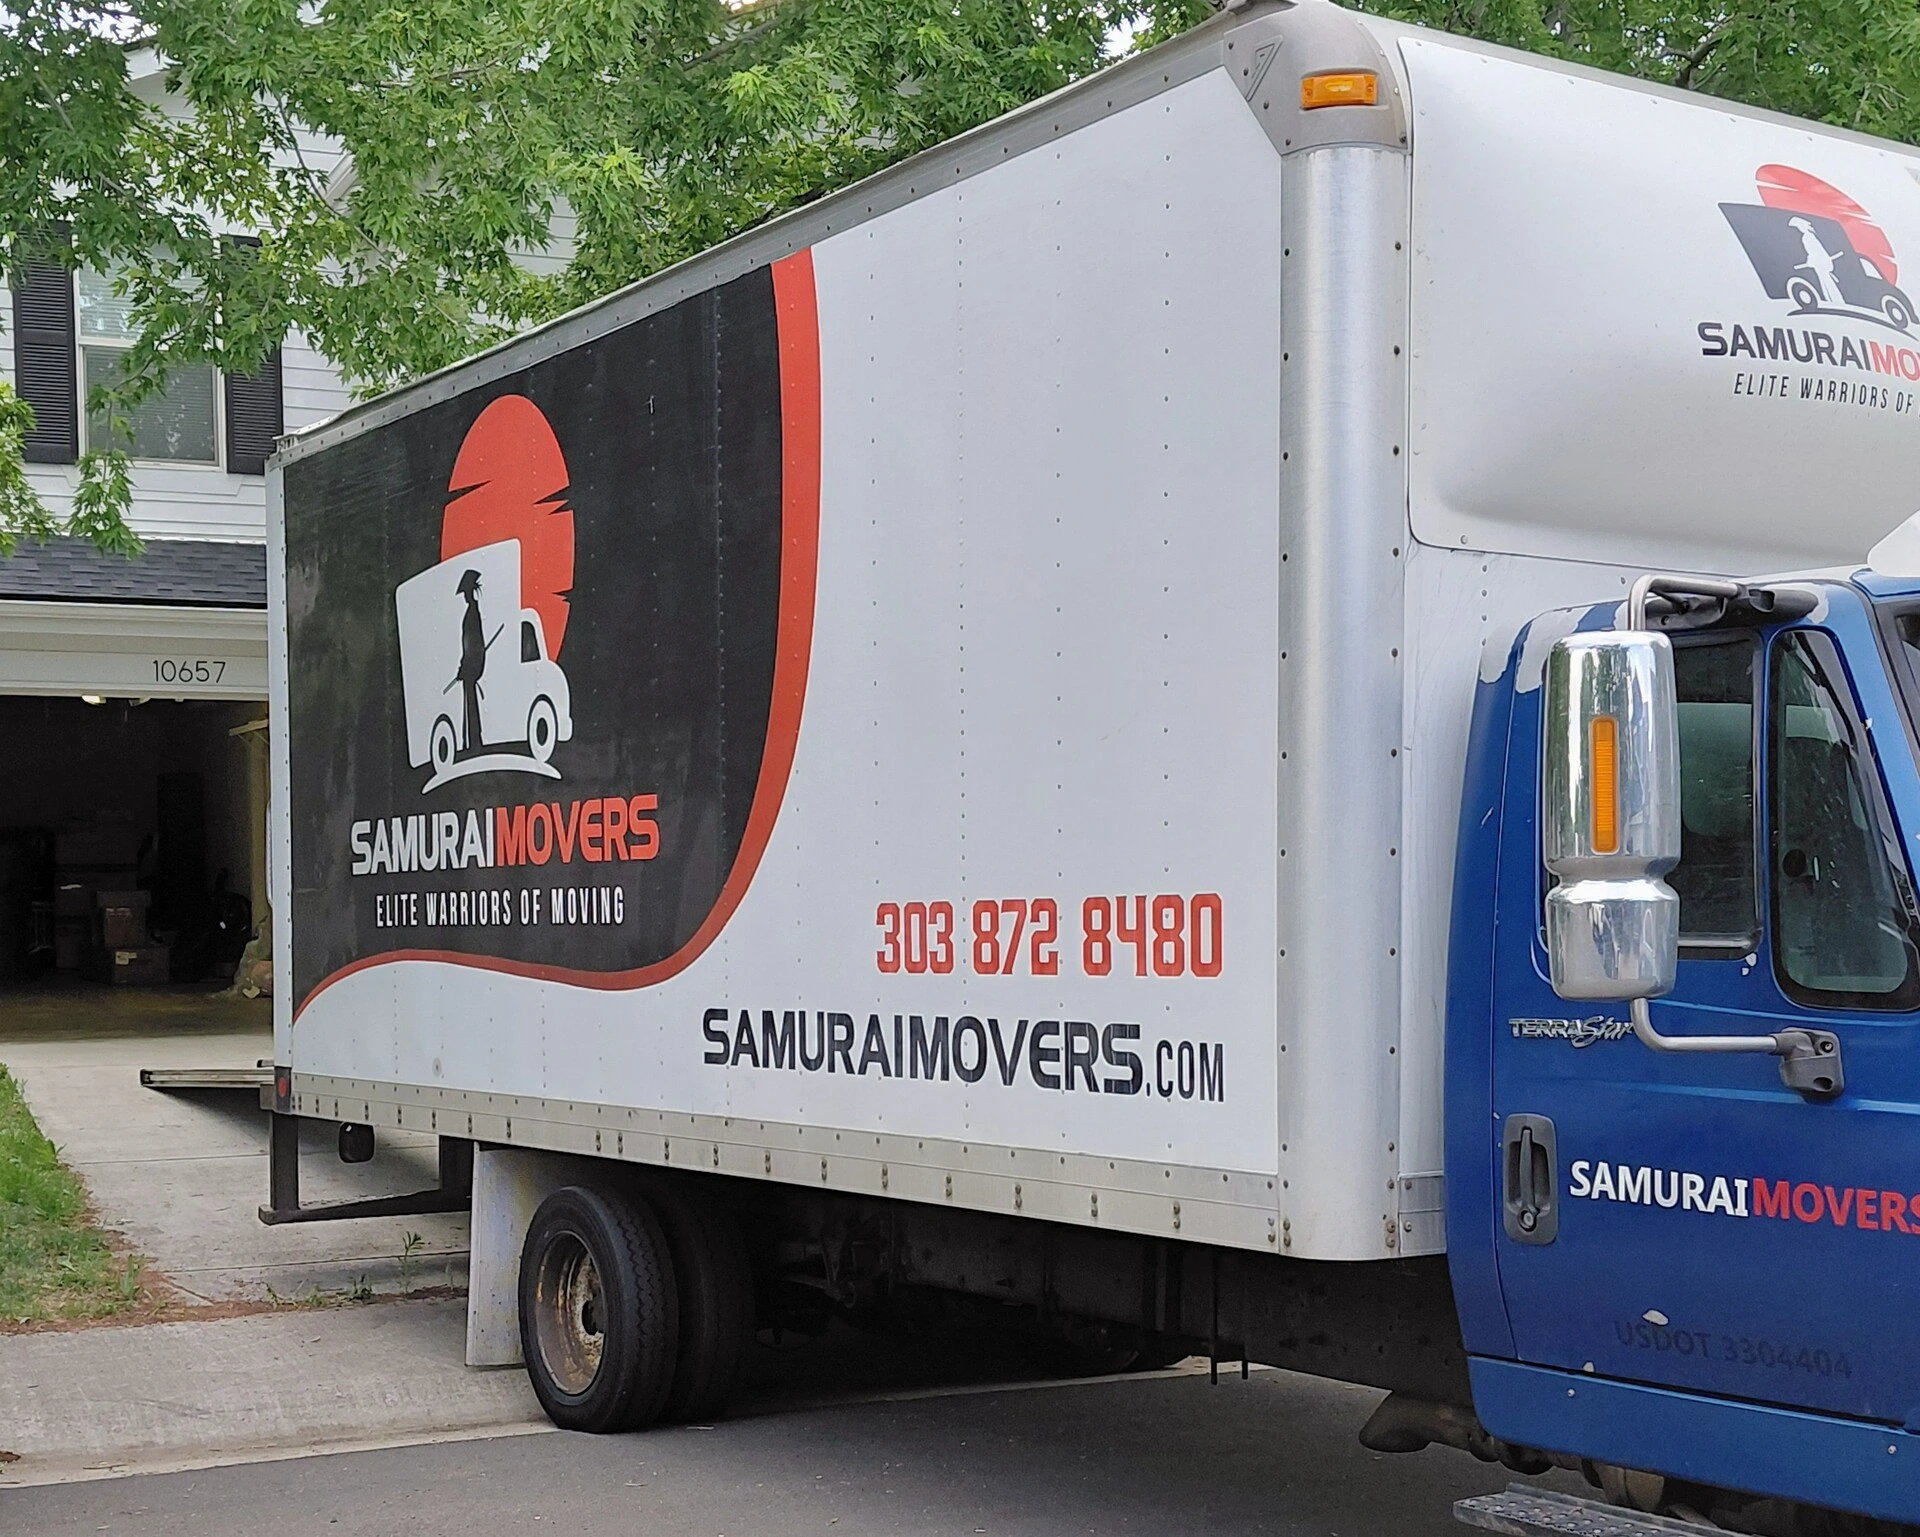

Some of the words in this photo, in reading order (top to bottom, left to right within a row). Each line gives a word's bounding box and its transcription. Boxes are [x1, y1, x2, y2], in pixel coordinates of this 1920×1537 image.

[1697, 322, 1920, 382] SAMURAIMO
[1733, 373, 1790, 397] ELITE
[1800, 377, 1888, 409] WARRIORS
[1895, 391, 1914, 414] OF
[152, 659, 226, 684] 10657
[351, 794, 660, 876] SAMURAIMOVERS
[376, 894, 418, 927] ELITE
[426, 890, 511, 926] WARRIORS
[520, 889, 542, 925] OF
[551, 886, 625, 925] MOVING
[875, 901, 955, 975] 303
[971, 898, 1059, 976] 872
[1082, 893, 1223, 978] 8480
[702, 1007, 1225, 1102] SAMURAIMOVERS.COM
[1613, 1320, 1712, 1359] USDOT
[1721, 1334, 1853, 1380] 3304404
